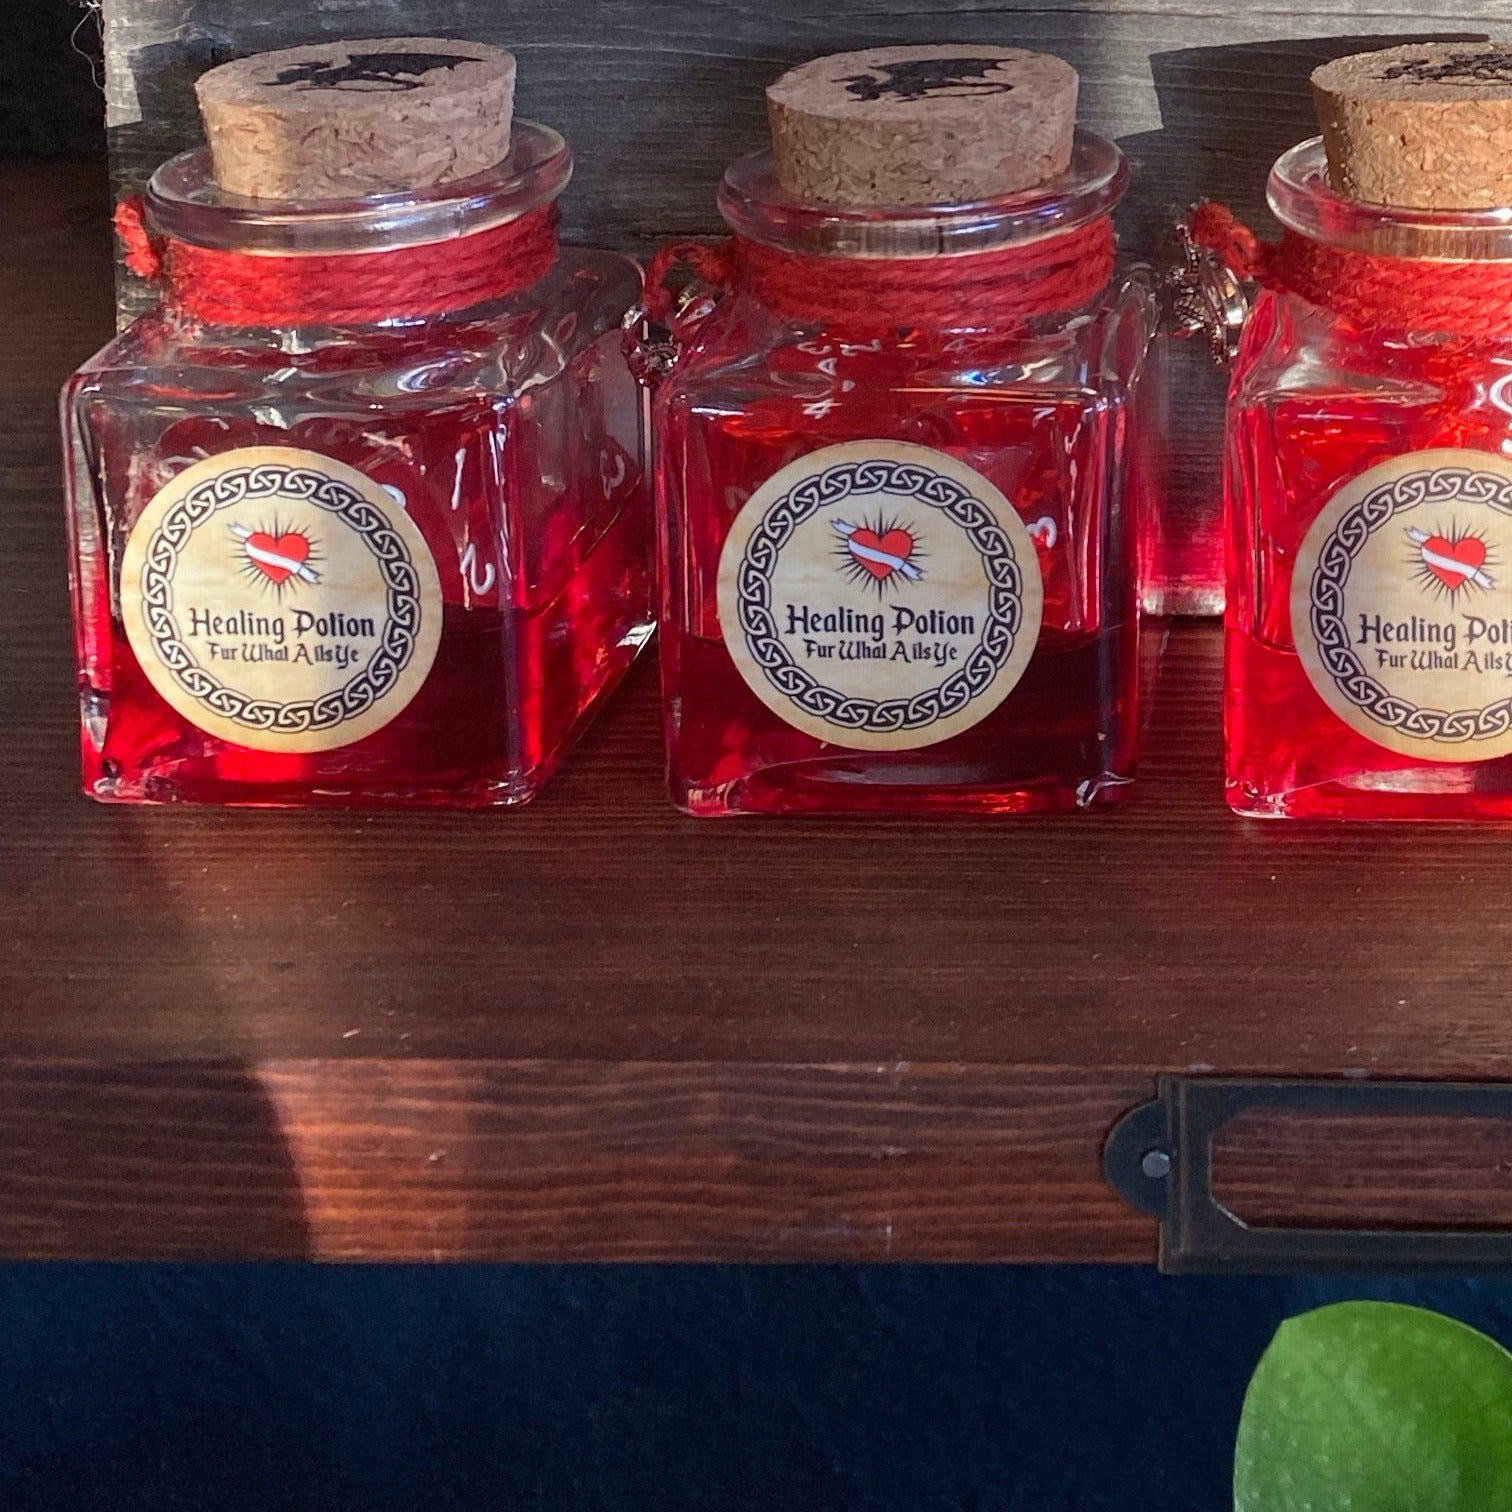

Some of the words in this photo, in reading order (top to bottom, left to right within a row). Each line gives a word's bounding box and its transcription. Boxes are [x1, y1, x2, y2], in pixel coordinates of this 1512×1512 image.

[188, 607, 284, 643] Healing
[291, 608, 375, 638] Potion
[784, 604, 884, 640] Healing
[889, 603, 975, 635] Potion
[1356, 613, 1456, 650] Healing
[205, 642, 240, 661] Fur
[241, 644, 288, 661] What
[290, 644, 334, 665] Ails
[335, 644, 359, 669] Ye
[801, 639, 838, 659] Fur
[838, 641, 887, 659] What
[889, 641, 932, 664] Ails
[934, 641, 957, 667] Ye
[1372, 649, 1407, 669] Fur
[1409, 651, 1458, 670] What
[1460, 651, 1503, 675] Ails
